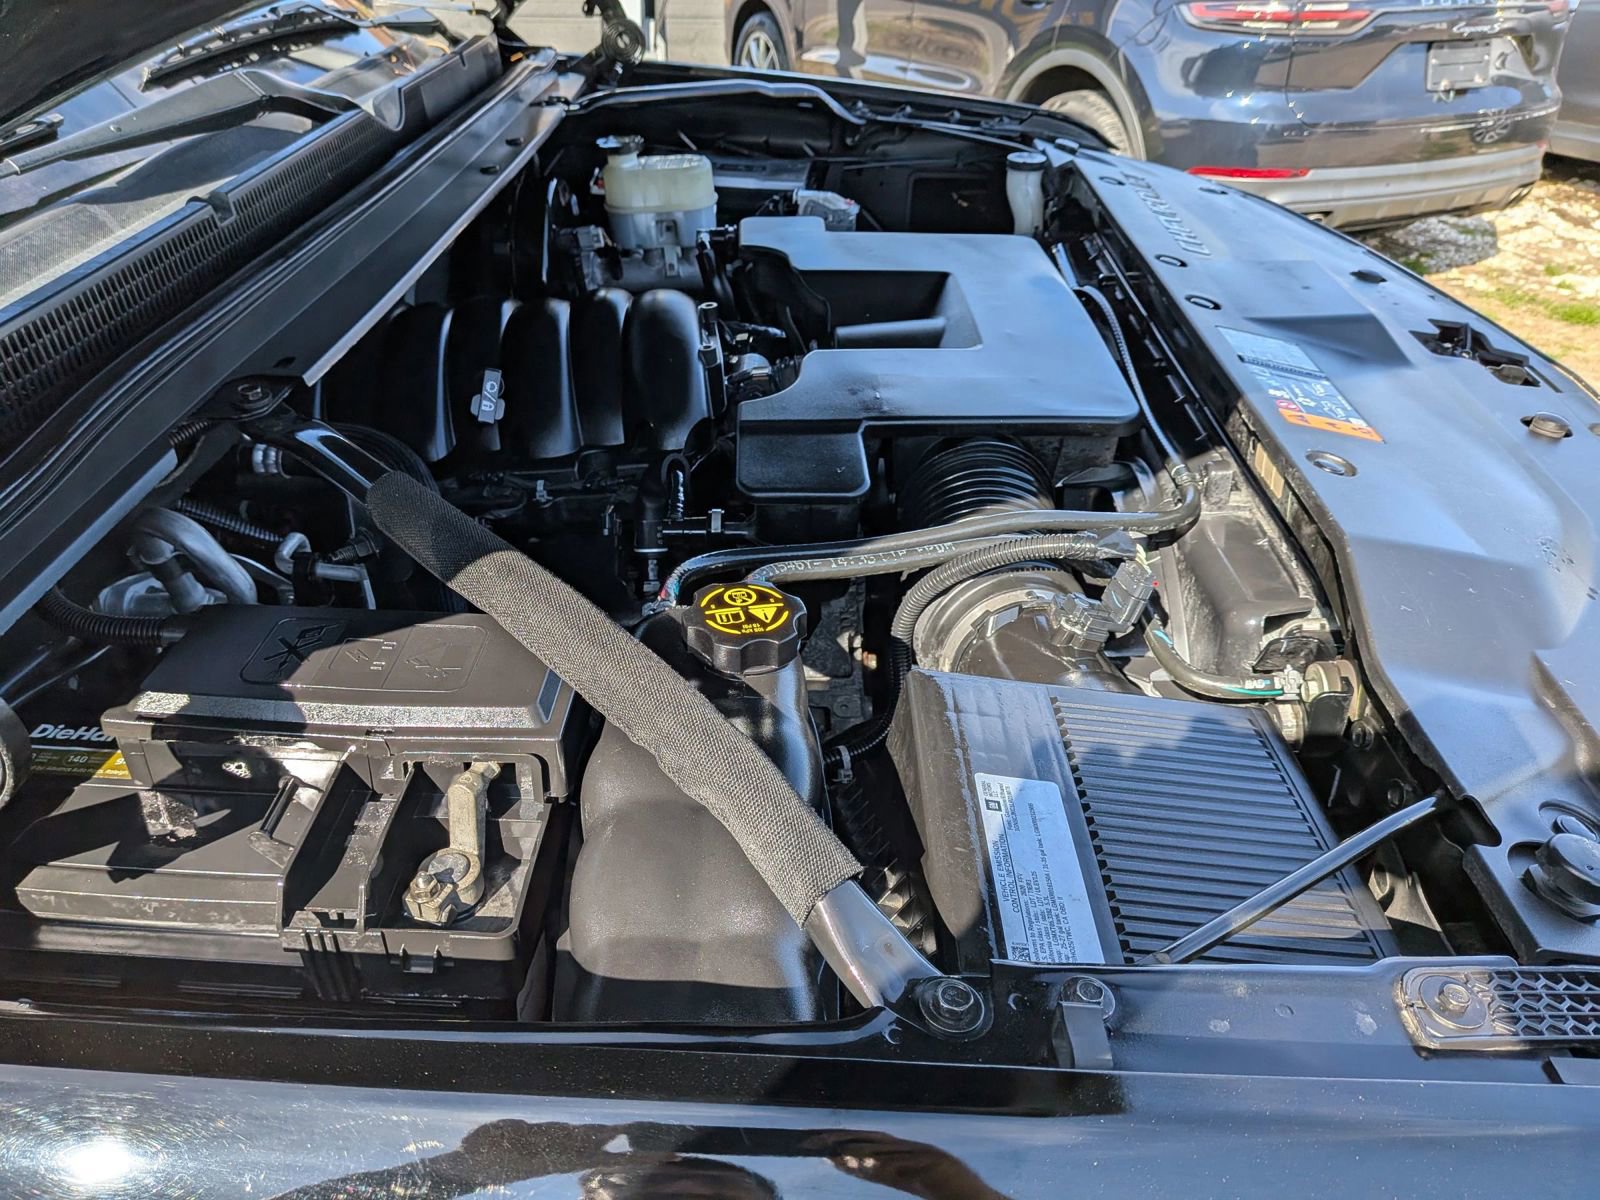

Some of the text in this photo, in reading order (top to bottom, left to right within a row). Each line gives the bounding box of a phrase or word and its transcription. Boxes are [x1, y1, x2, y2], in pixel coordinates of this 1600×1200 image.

[68, 755, 88, 764] 140
[992, 840, 1010, 902] VEHICLE EMISSION
[998, 834, 1020, 913] CONTROL INFORMATION
[1031, 940, 1041, 962] onforms
[1046, 942, 1056, 962] alifornia
